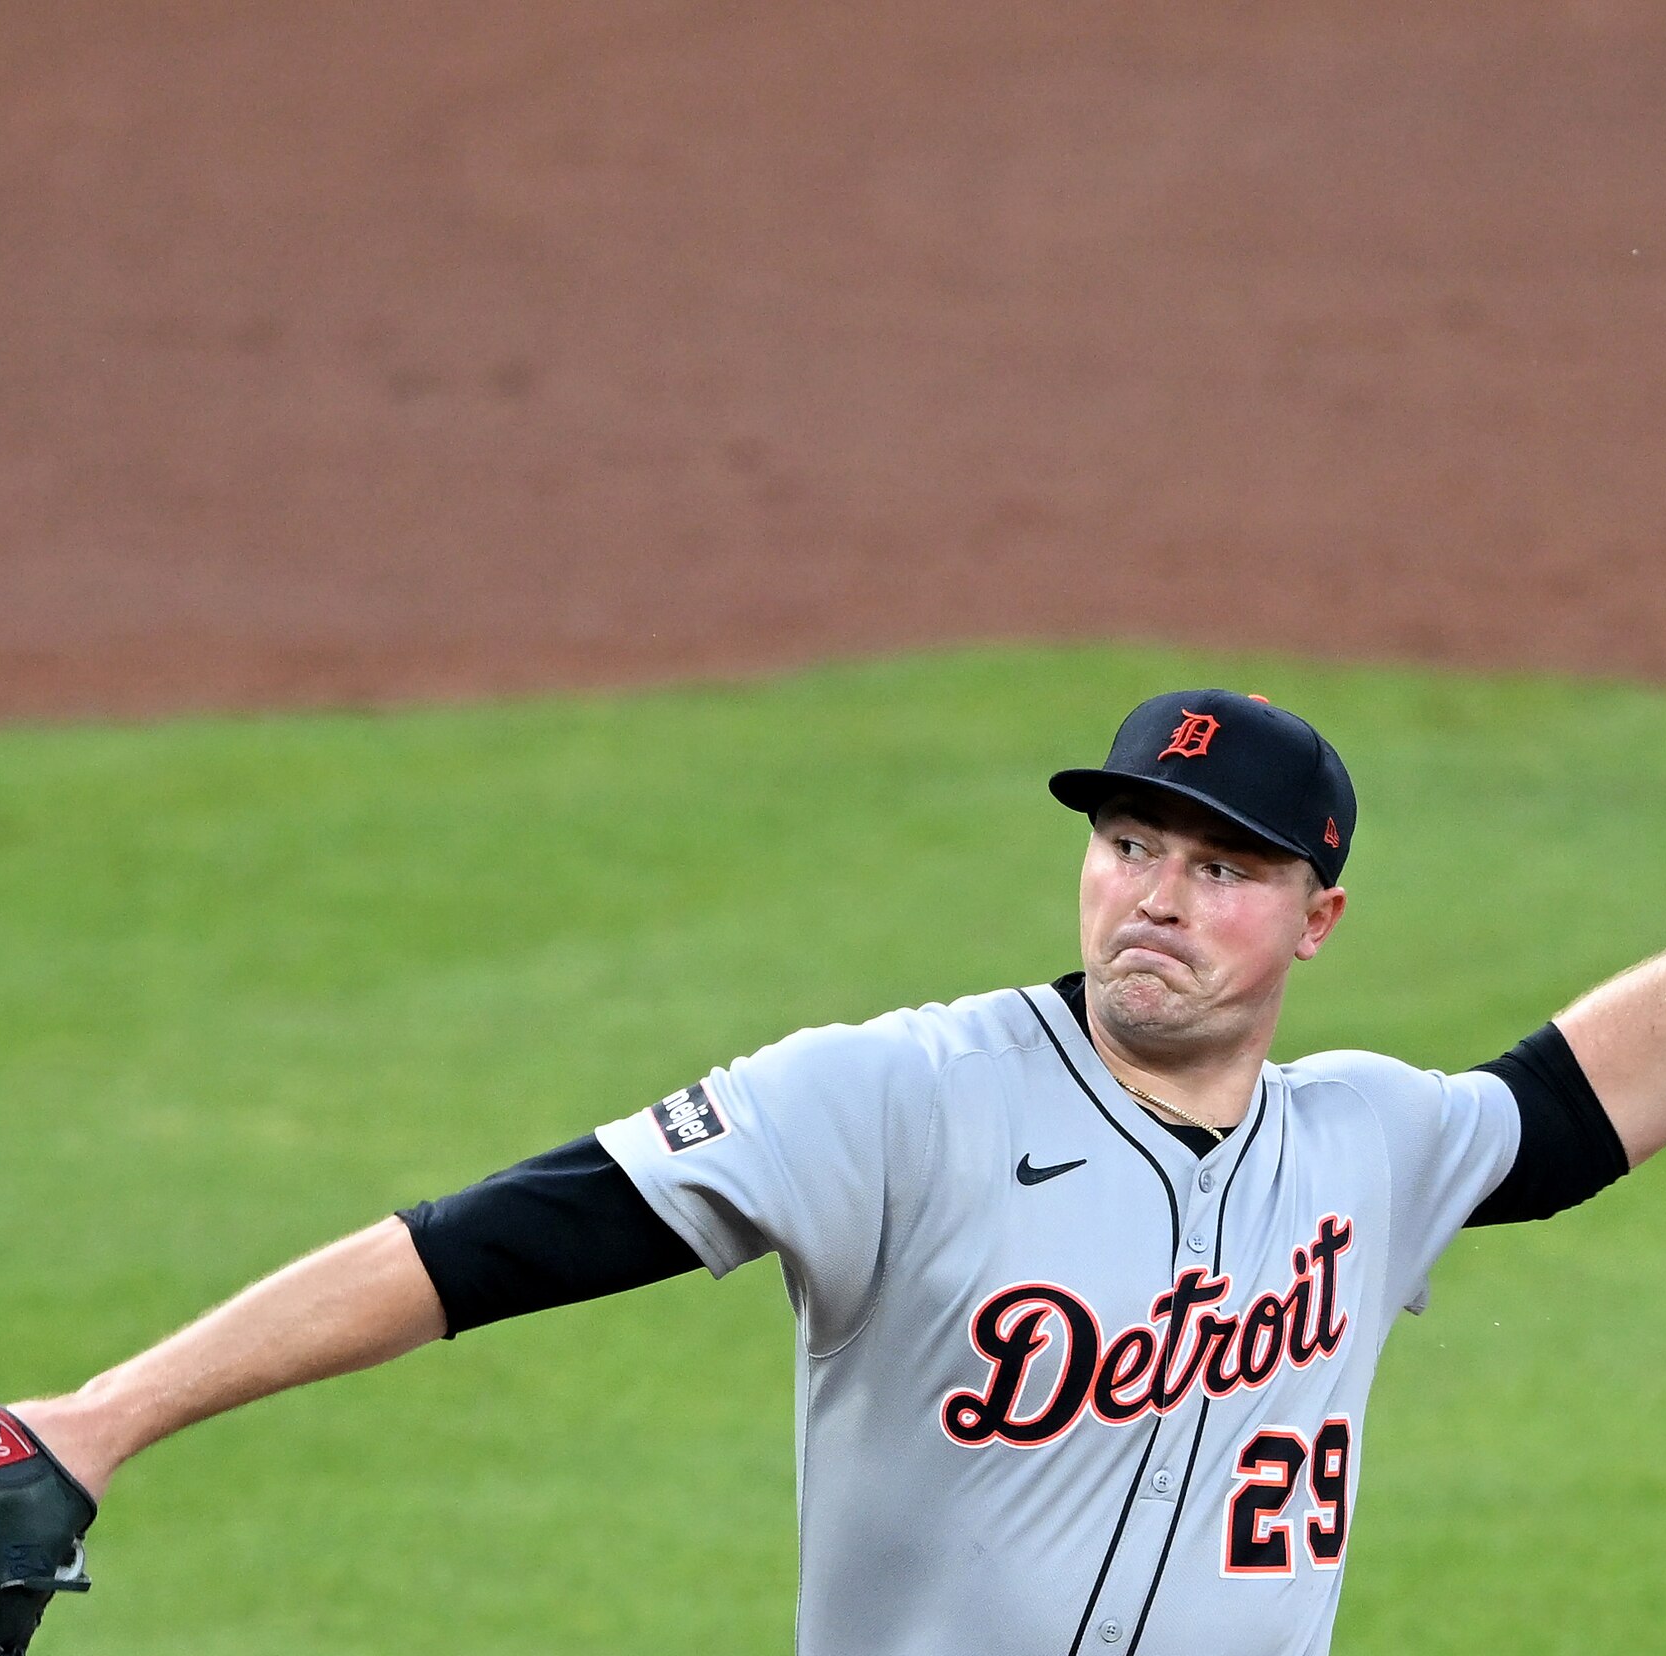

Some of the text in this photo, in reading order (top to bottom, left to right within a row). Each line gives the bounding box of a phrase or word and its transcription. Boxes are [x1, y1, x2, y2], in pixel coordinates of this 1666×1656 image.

[1157, 708, 1221, 761] D
[940, 1212, 1353, 1449] Detroit
[1219, 1412, 1351, 1580] 29
